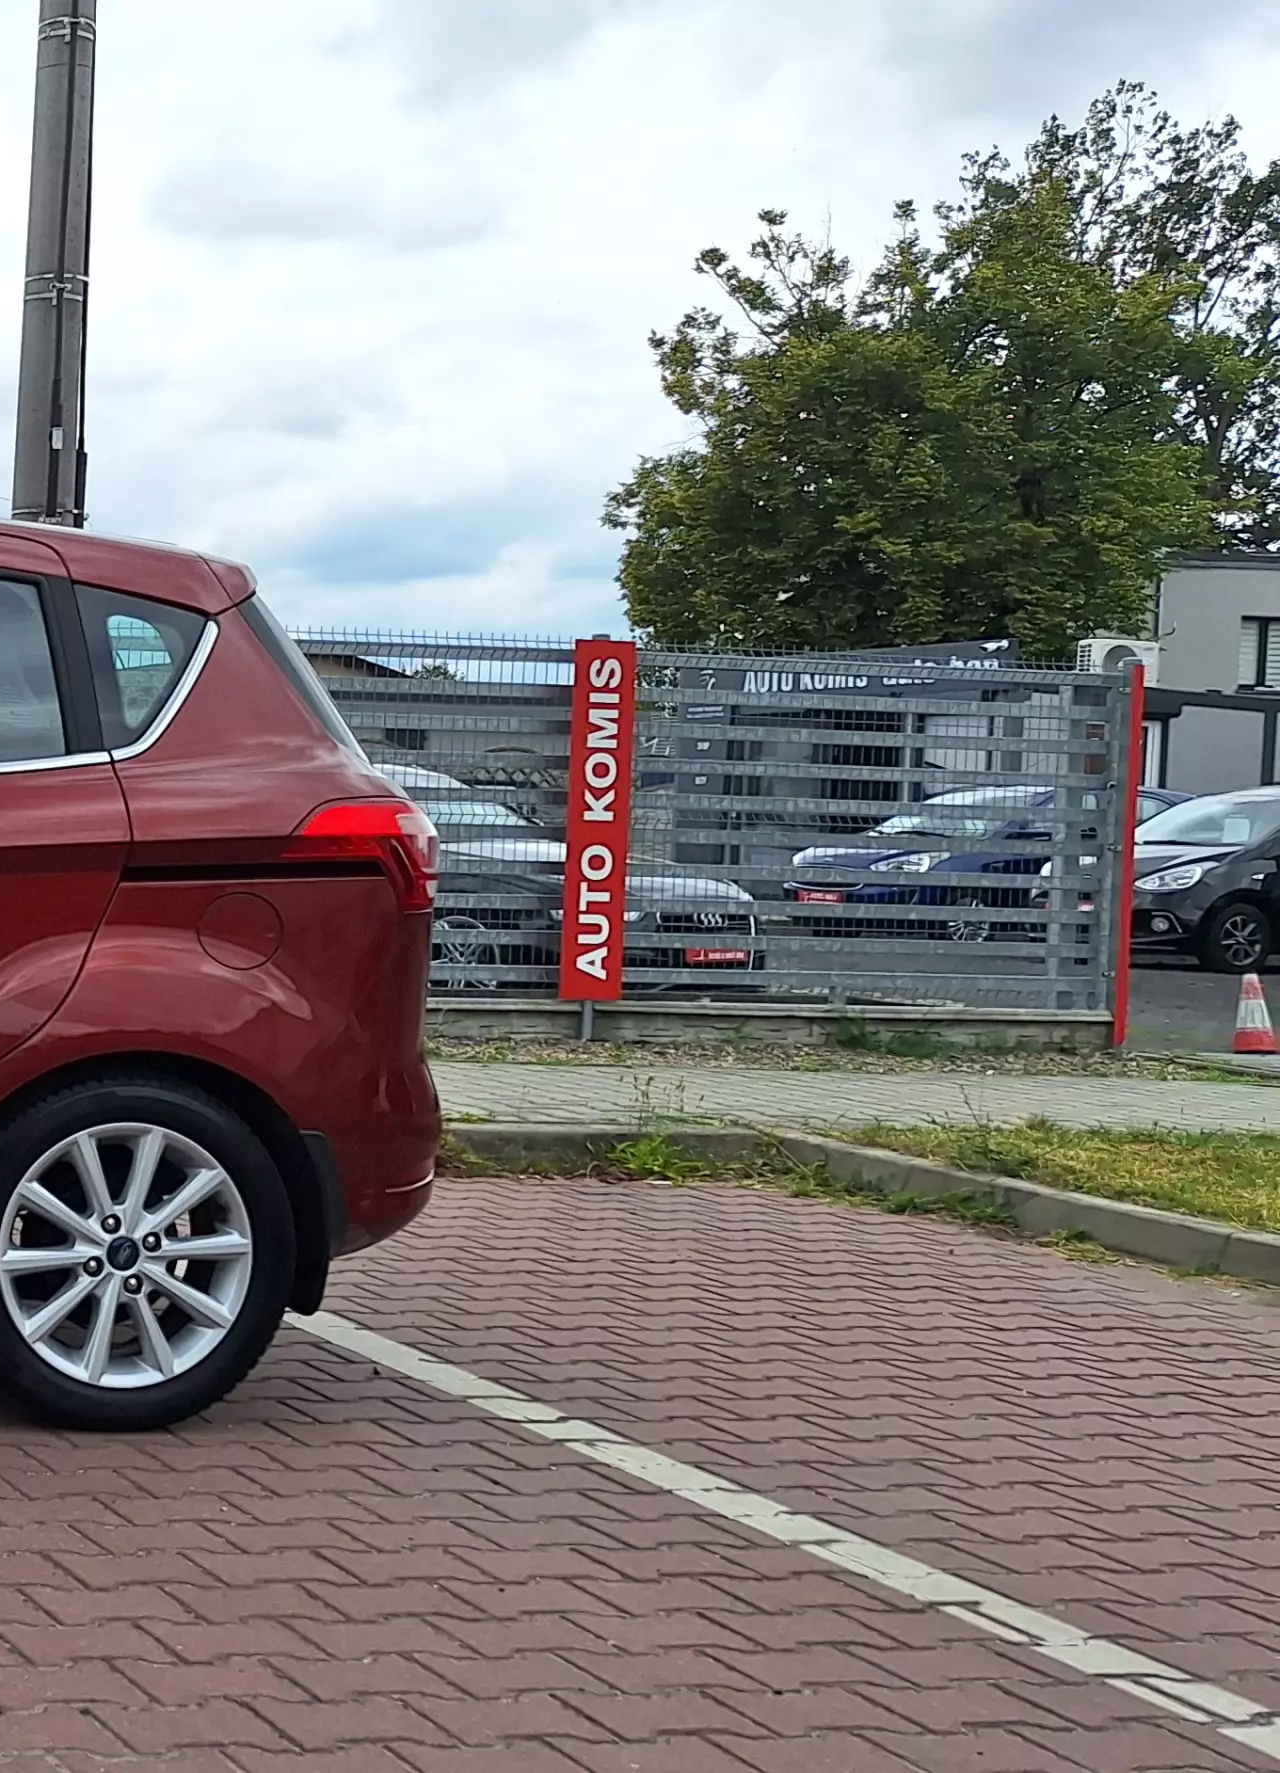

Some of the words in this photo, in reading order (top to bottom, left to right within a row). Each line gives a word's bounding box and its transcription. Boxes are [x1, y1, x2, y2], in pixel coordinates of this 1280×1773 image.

[582, 657, 623, 823] KOMIS
[743, 671, 793, 693] AUTO
[575, 844, 614, 981] AUTO
